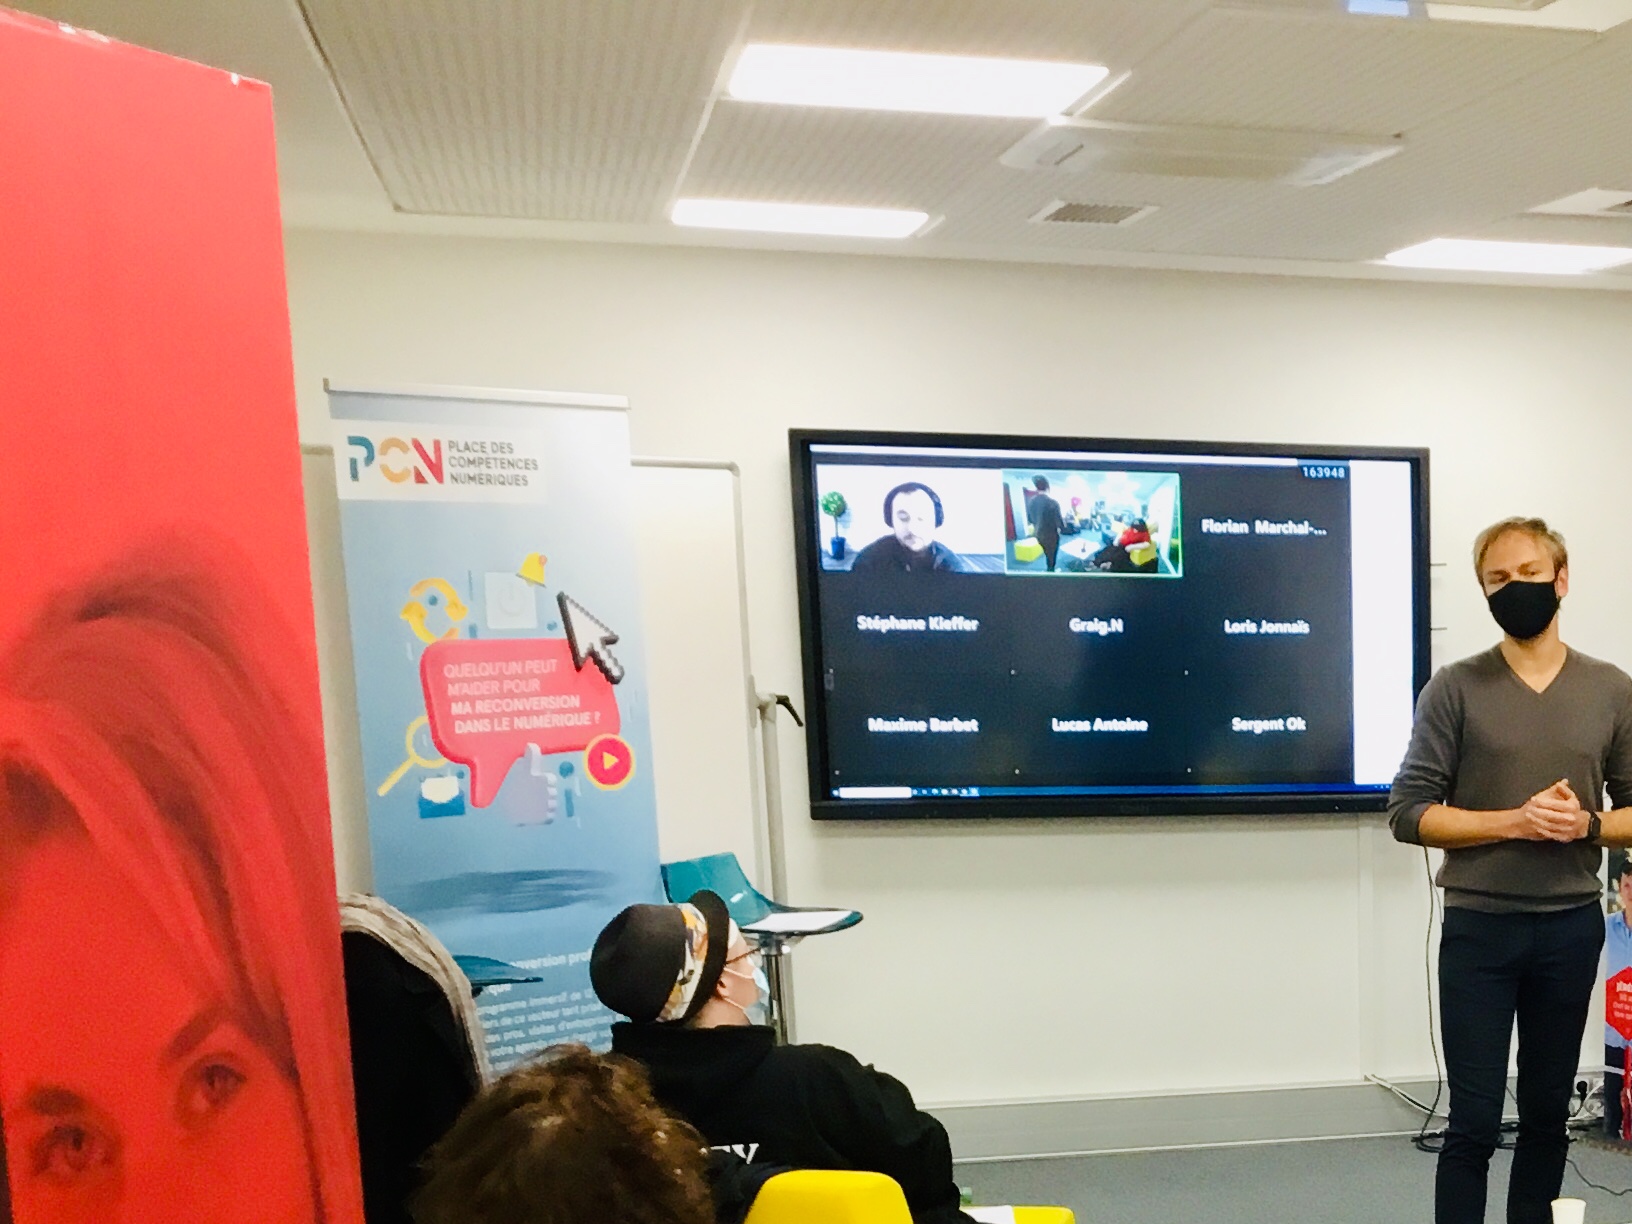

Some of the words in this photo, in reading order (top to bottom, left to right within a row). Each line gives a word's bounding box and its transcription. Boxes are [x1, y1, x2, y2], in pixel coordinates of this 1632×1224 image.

[448, 440, 487, 454] PLACE
[491, 442, 514, 454] DES
[347, 436, 444, 484] PCN
[1303, 467, 1345, 478] 163948
[1201, 518, 1249, 534] Florian
[857, 615, 926, 634] Stéphane
[928, 615, 979, 631] Kieffer
[1224, 619, 1258, 634] Loris
[443, 662, 522, 679] QUELQU'UN
[525, 659, 558, 674] PEUT
[447, 680, 500, 696] M'AIDER
[503, 678, 541, 693] POUR
[451, 701, 472, 716] MA
[475, 695, 581, 714] RECONVERSION
[455, 718, 491, 734] DANS
[494, 717, 510, 731] LE
[514, 711, 592, 730] NUMÉRIQUE
[868, 717, 927, 732] Maxime
[929, 717, 979, 732] Barbet
[1051, 717, 1091, 732] Lucas
[1093, 717, 1149, 732] Antoine
[1231, 716, 1284, 734] Sergent
[1286, 716, 1307, 731] Ok
